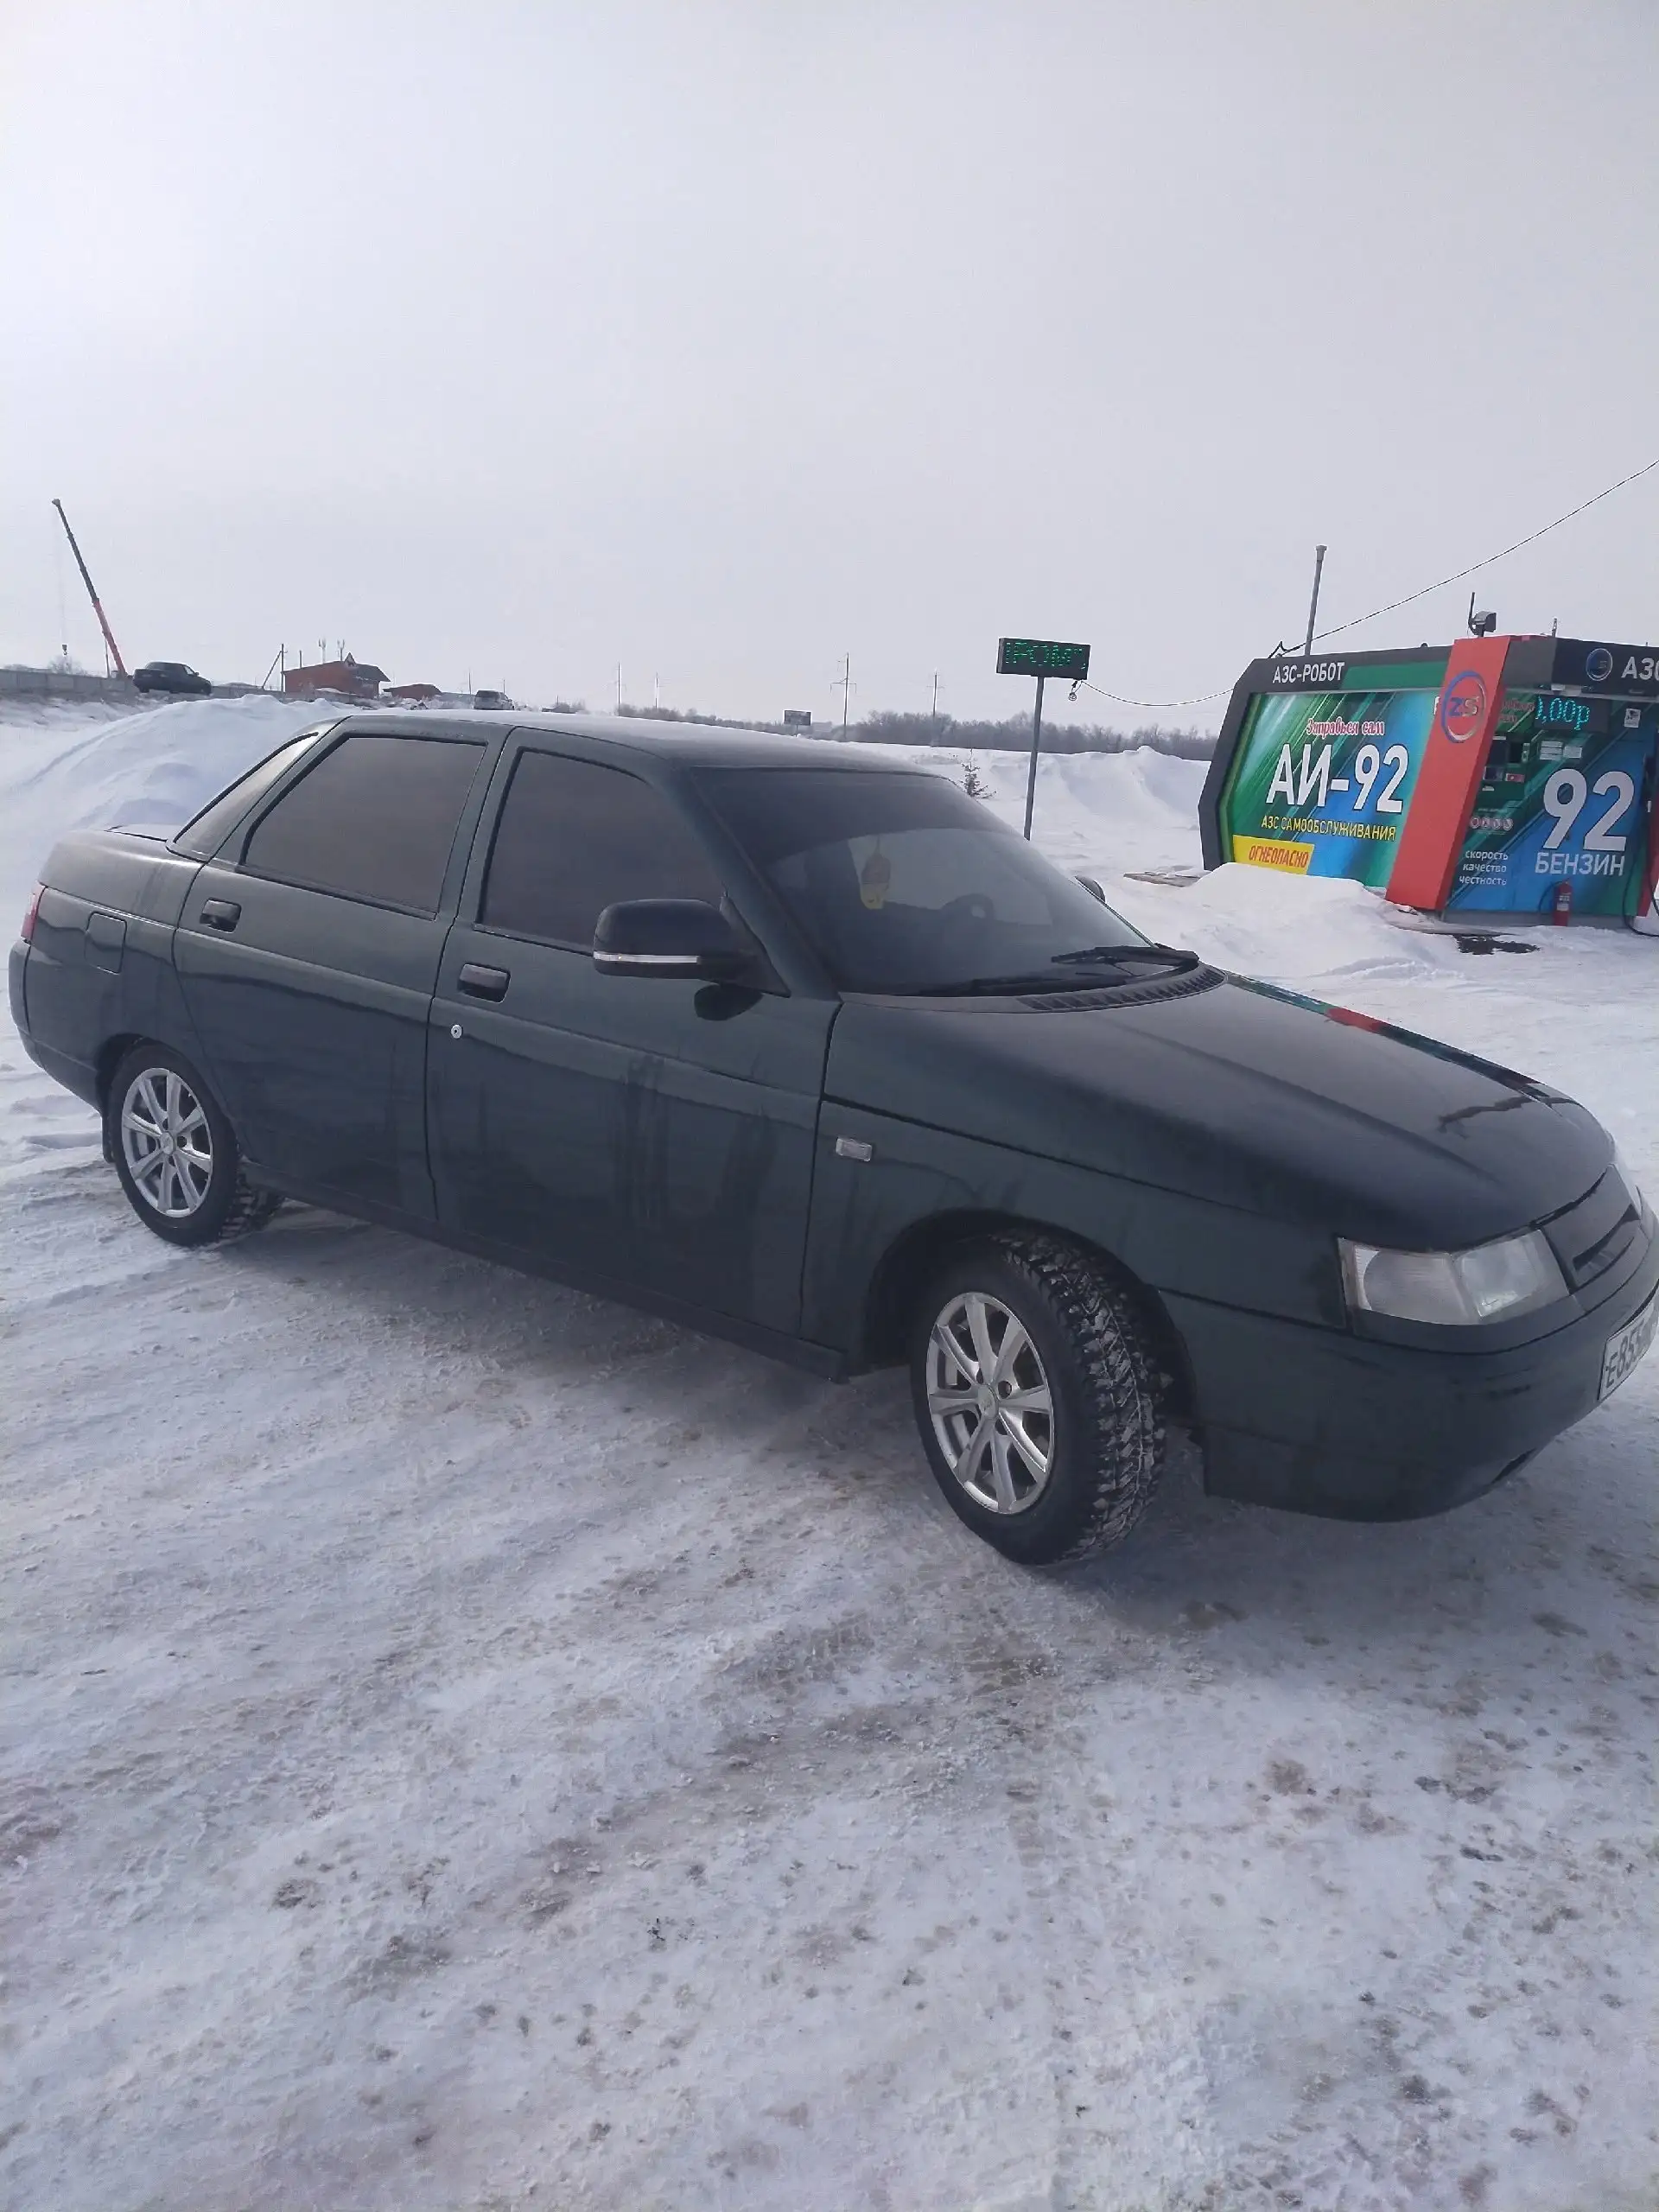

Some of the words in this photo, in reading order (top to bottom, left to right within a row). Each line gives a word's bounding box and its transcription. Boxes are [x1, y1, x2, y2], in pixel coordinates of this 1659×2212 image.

[1273, 662, 1345, 683] АЗС-РОБОТ
[1361, 721, 1385, 735] сам
[1266, 744, 1408, 813] АИ-92
[1542, 768, 1635, 851] 92
[1262, 816, 1280, 830] АЗС
[1281, 817, 1396, 842] САМООБСЛУЖИВАНИЯ
[1249, 845, 1309, 868] ОГНЕОПАСНО
[1465, 850, 1509, 861] скорость
[1535, 852, 1625, 876] БЕНЗИН
[1462, 863, 1507, 873] качество
[1459, 875, 1508, 886] честность
